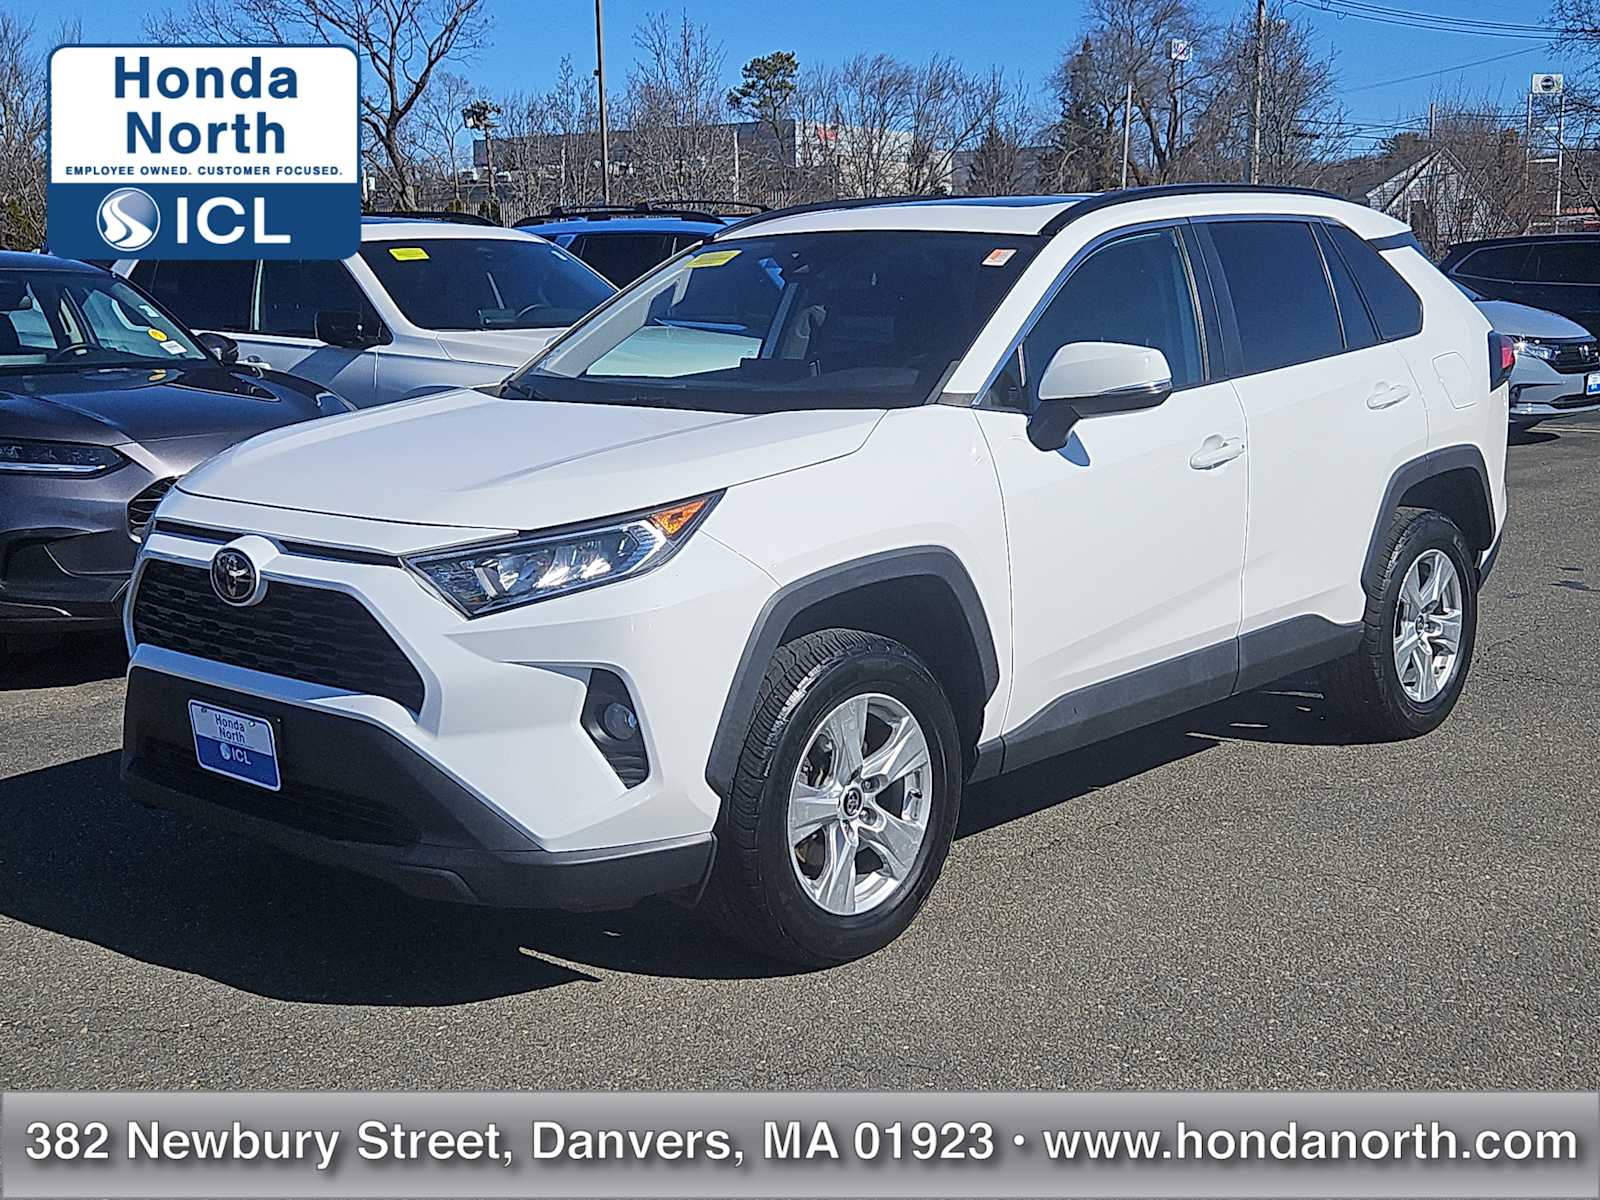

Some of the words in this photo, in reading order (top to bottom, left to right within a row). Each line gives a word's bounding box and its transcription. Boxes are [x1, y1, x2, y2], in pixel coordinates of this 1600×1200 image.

[214, 713, 245, 733] Honda
[219, 726, 246, 745] North
[231, 746, 252, 766] ICL
